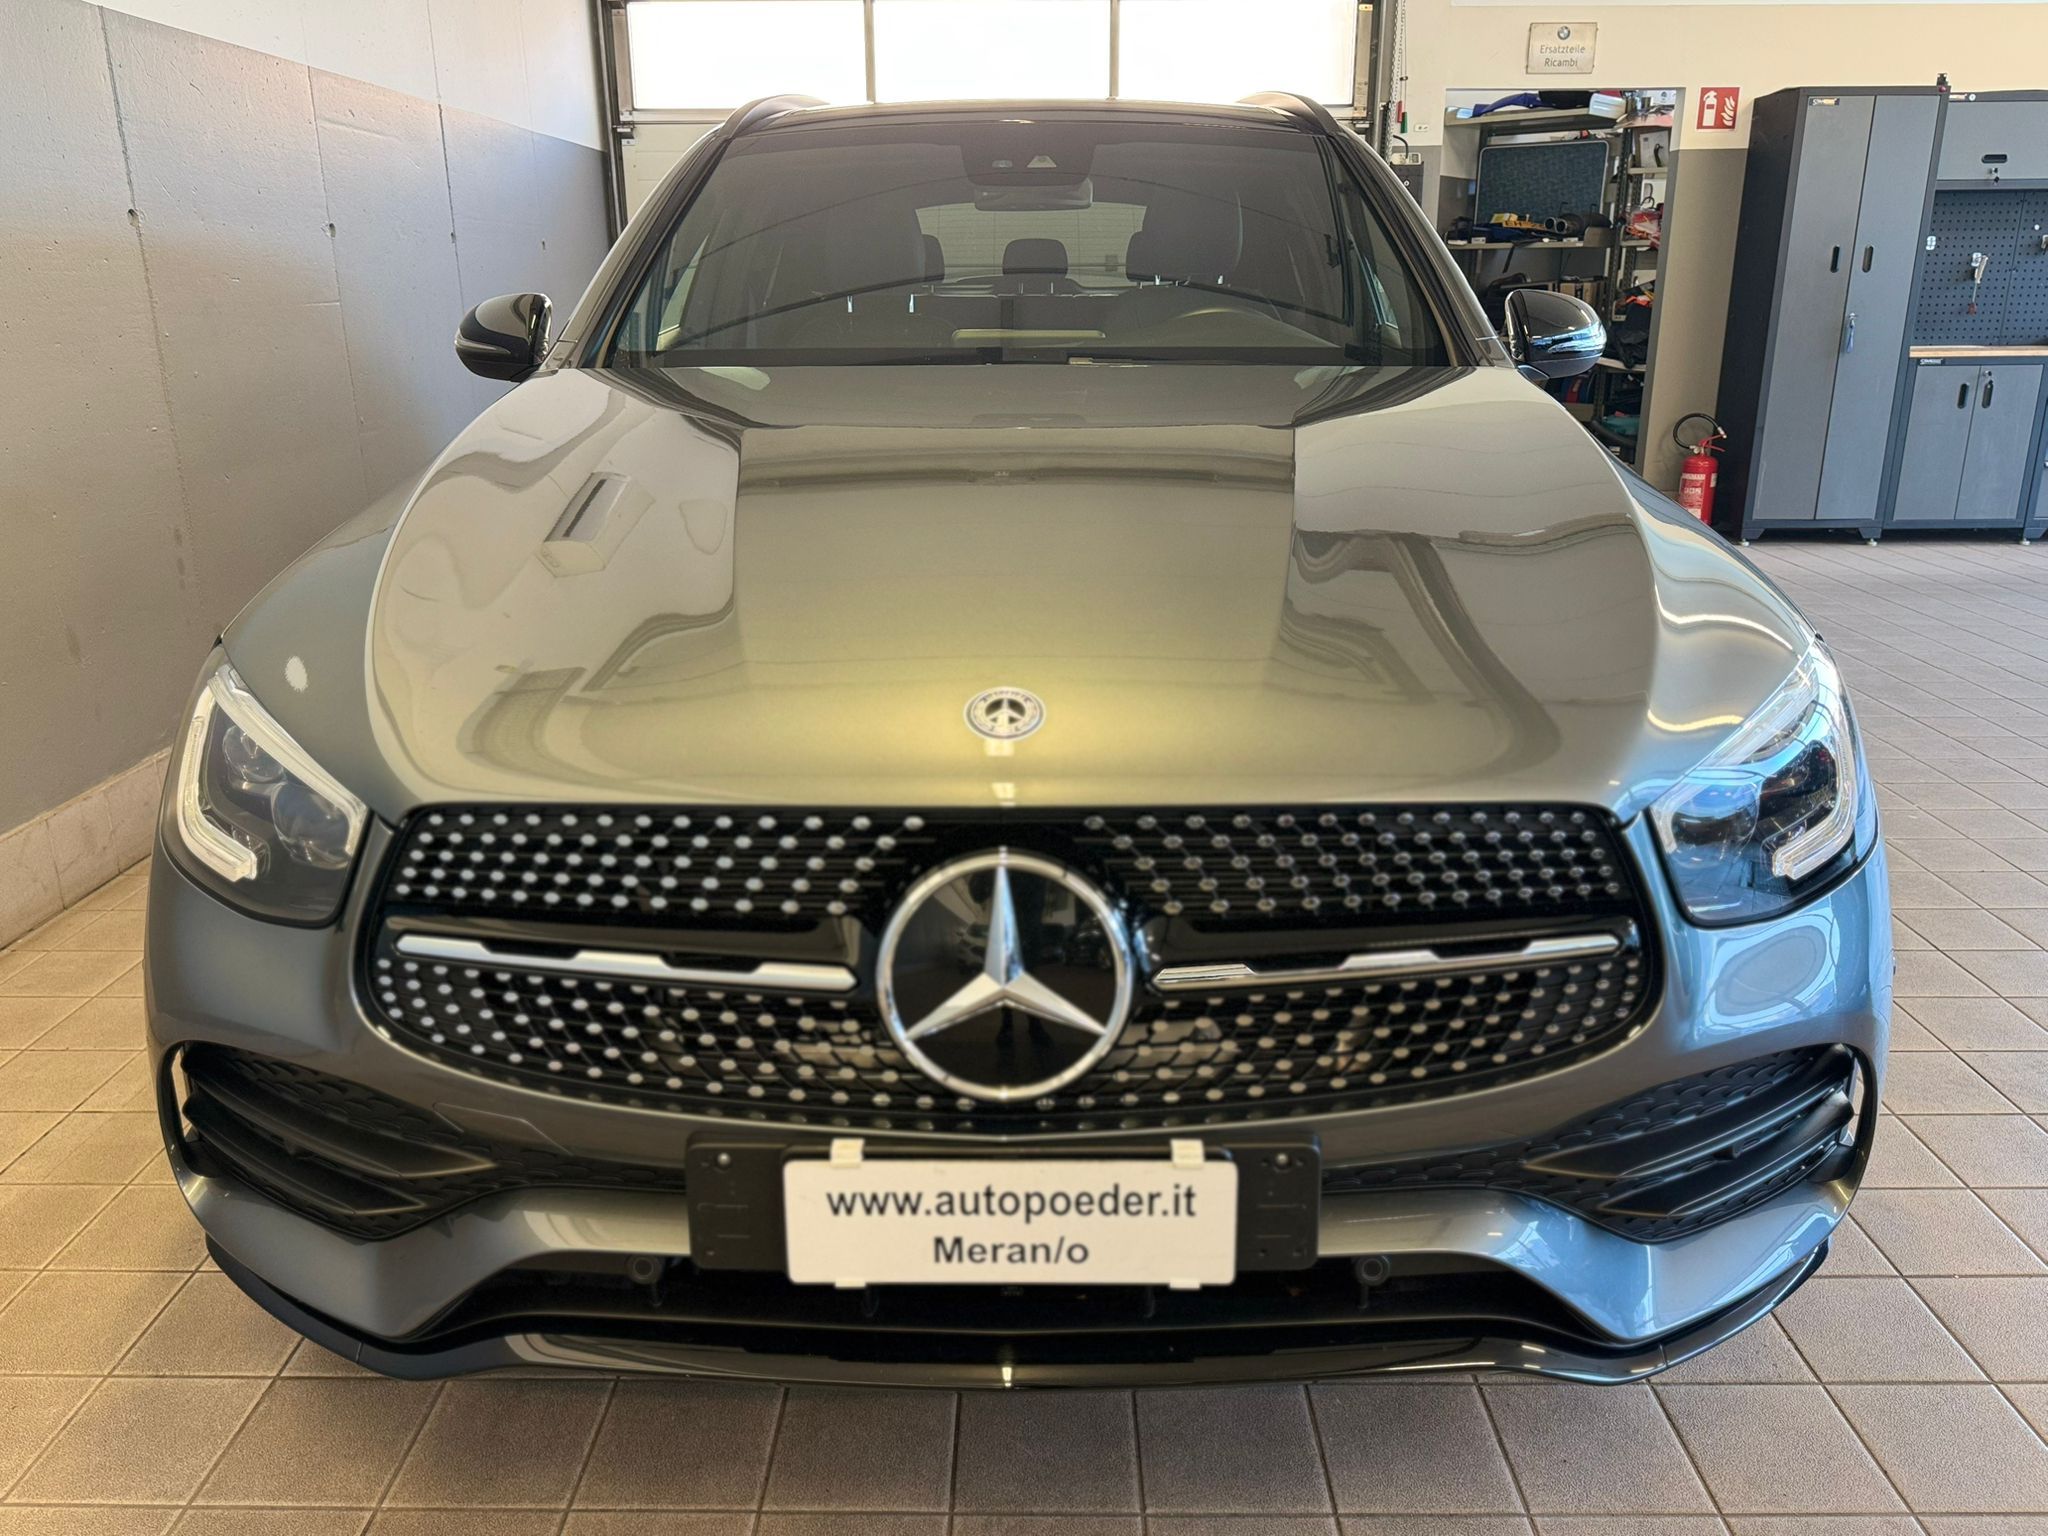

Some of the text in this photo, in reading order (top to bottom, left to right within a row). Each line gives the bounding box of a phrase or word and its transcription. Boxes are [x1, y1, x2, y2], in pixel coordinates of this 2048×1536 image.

[1540, 45, 1586, 54] Ersatzteile
[1544, 58, 1578, 67] Ricambi
[827, 1184, 1195, 1223] www.autopoeder.it
[935, 1237, 1088, 1263] Meran/o
